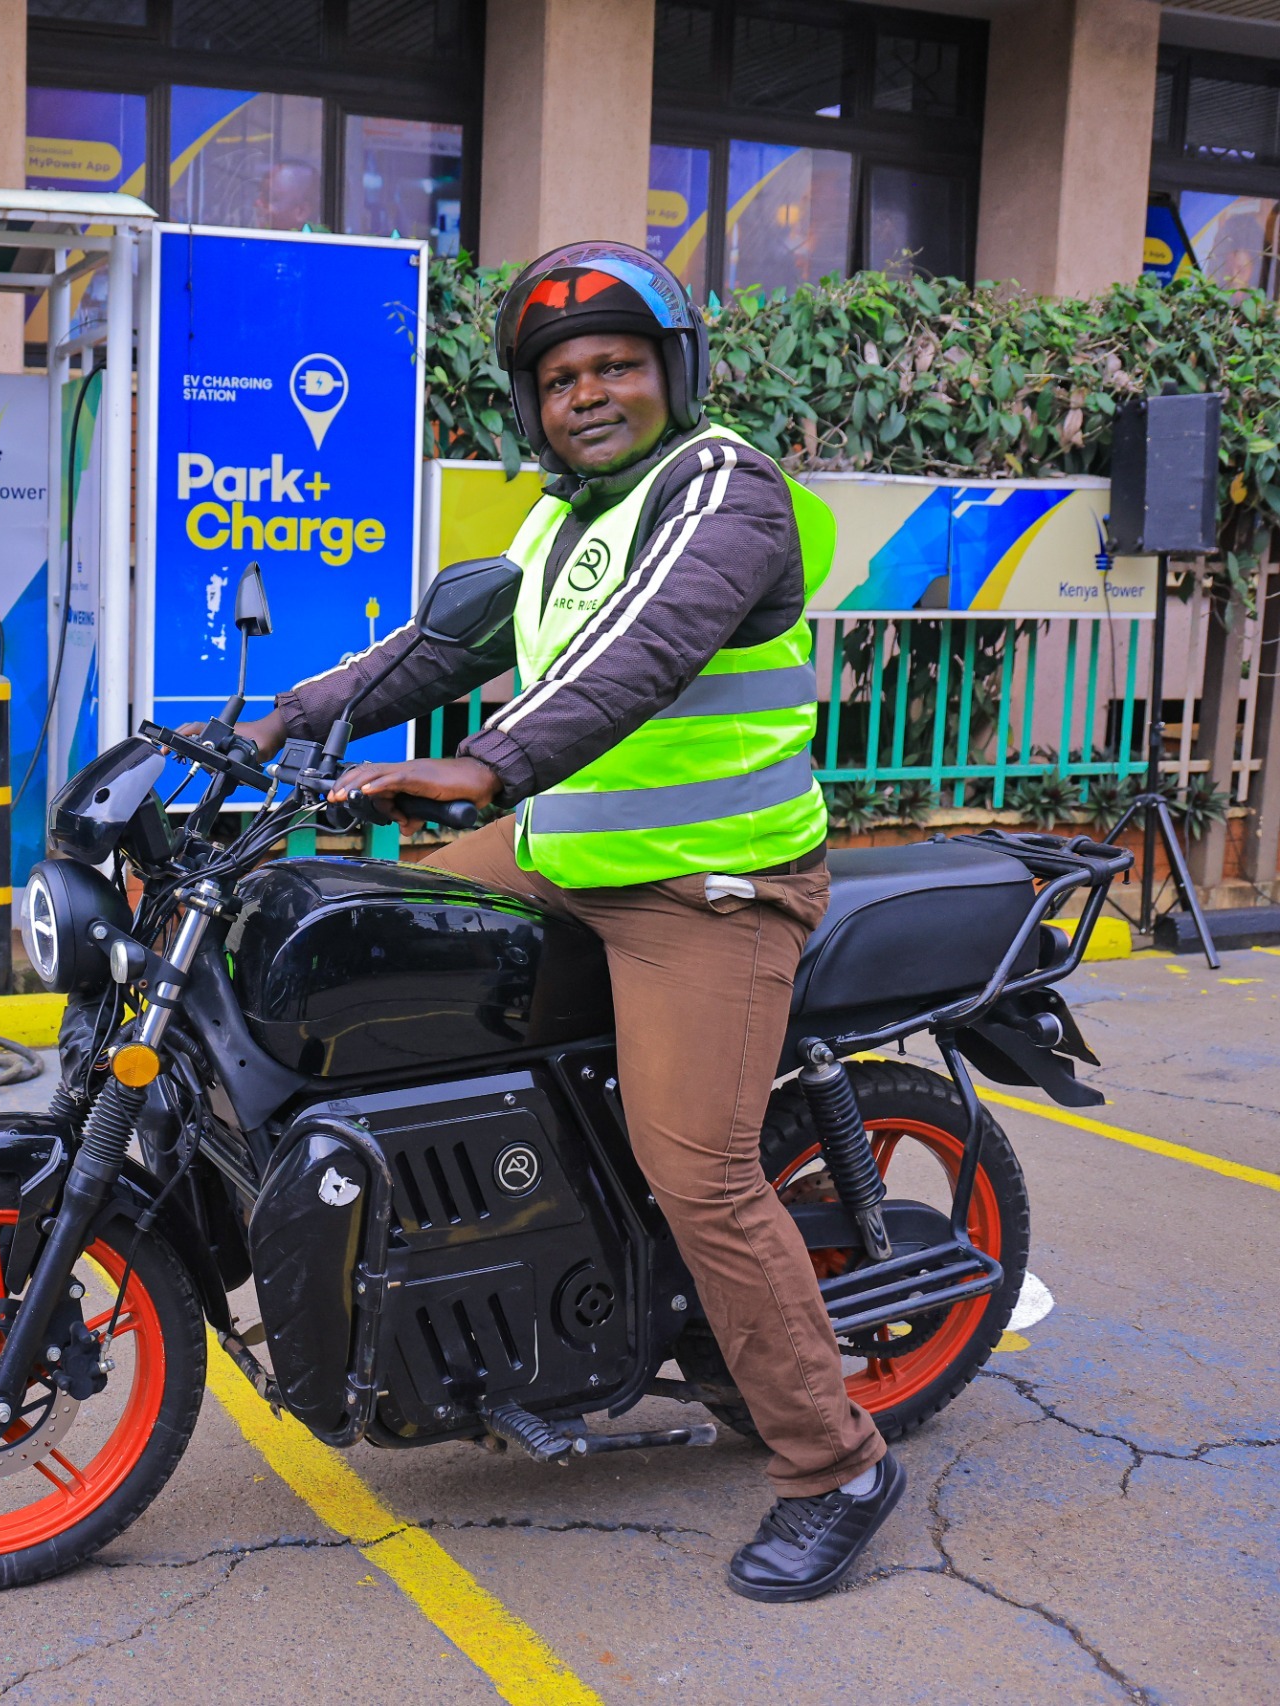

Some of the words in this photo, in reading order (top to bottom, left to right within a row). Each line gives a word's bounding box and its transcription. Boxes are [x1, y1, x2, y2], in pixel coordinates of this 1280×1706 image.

[29, 157, 82, 168] MyPower
[86, 161, 110, 172] App
[183, 374, 200, 387] EV
[202, 375, 273, 390] CHARGING
[183, 388, 236, 402] STATION
[185, 501, 386, 567] Charge
[1059, 582, 1098, 602] Kenya
[1104, 582, 1145, 597] Power
[553, 597, 574, 610] ARC
